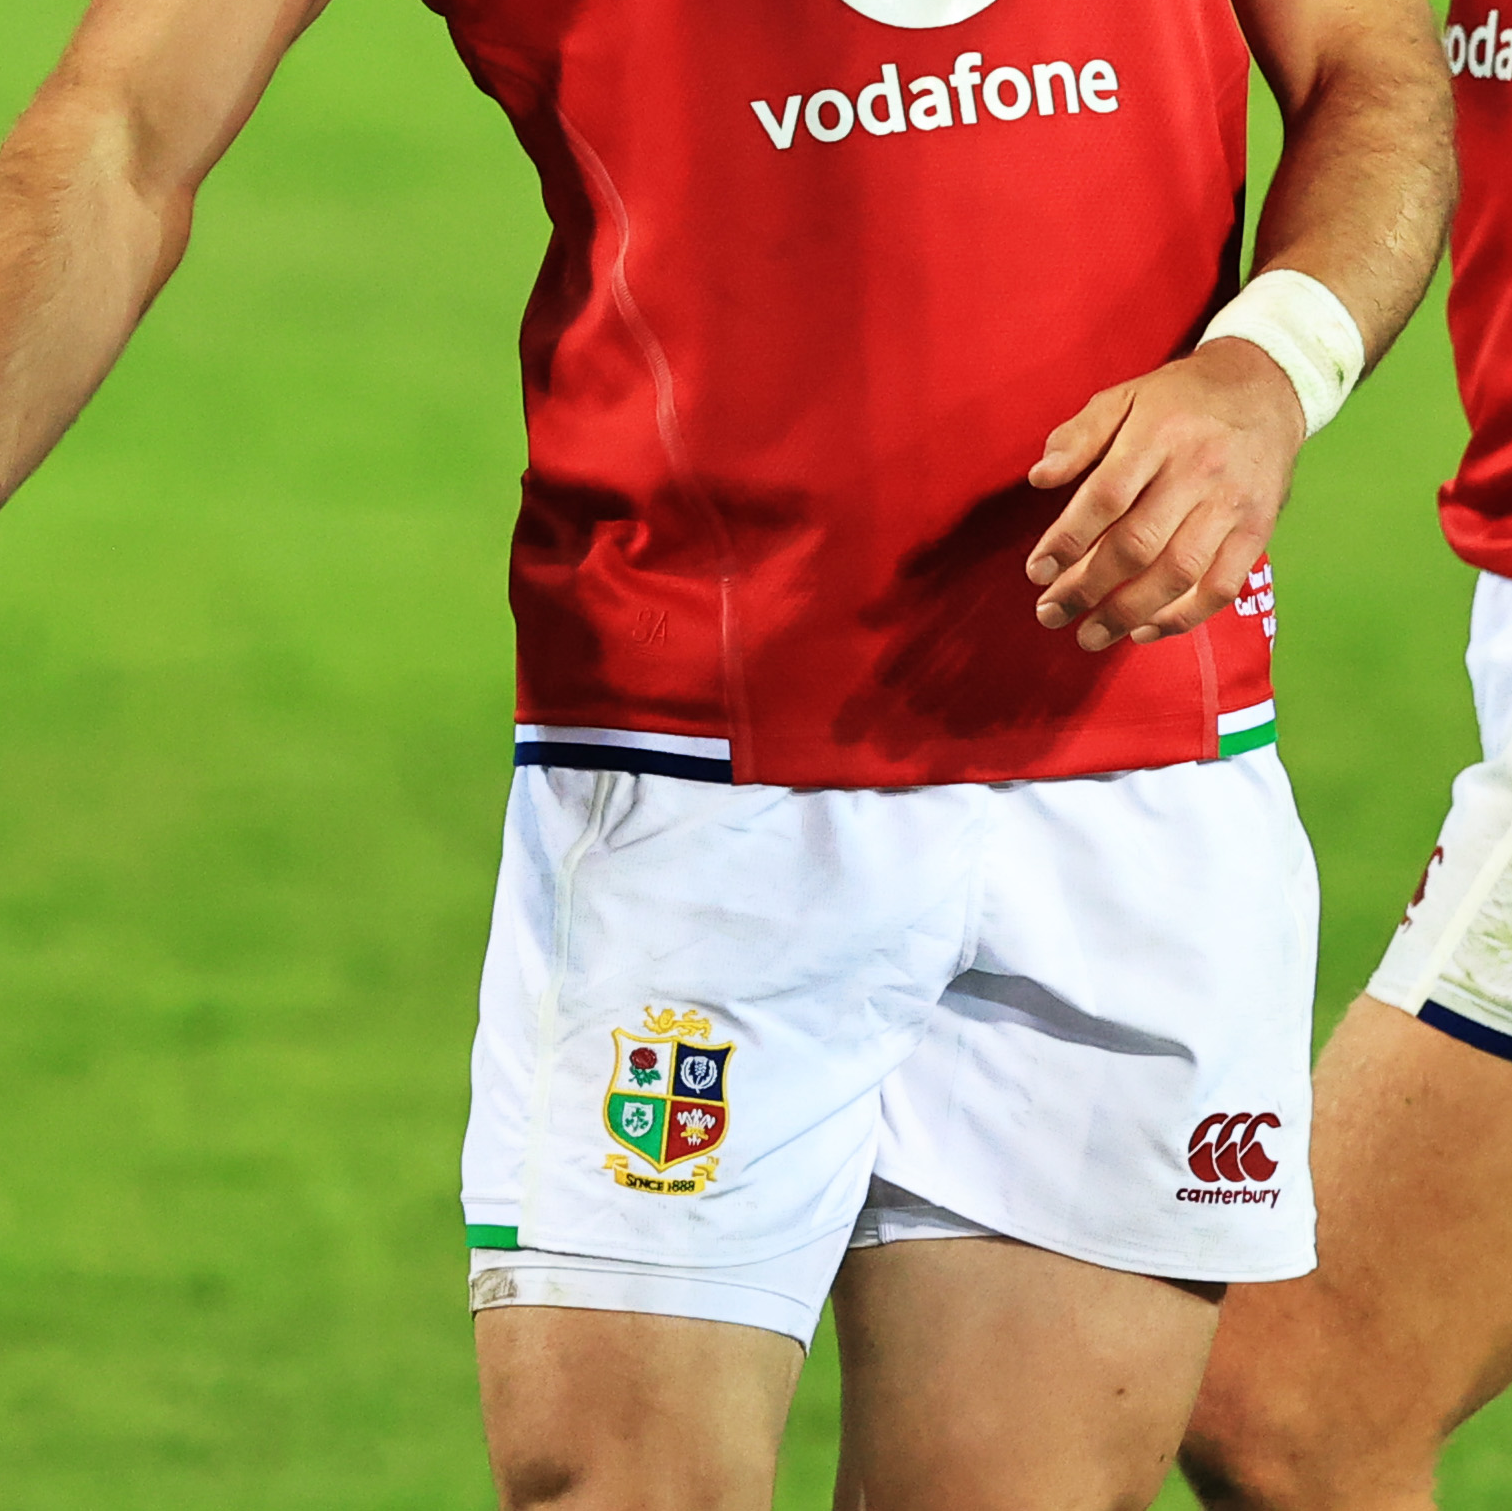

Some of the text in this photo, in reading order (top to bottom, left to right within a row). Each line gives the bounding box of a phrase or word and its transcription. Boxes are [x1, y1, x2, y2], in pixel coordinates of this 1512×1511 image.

[749, 51, 1120, 150] vodafone
[625, 1173, 696, 1193] SINCE 1888
[1175, 1185, 1282, 1210] canterbury
